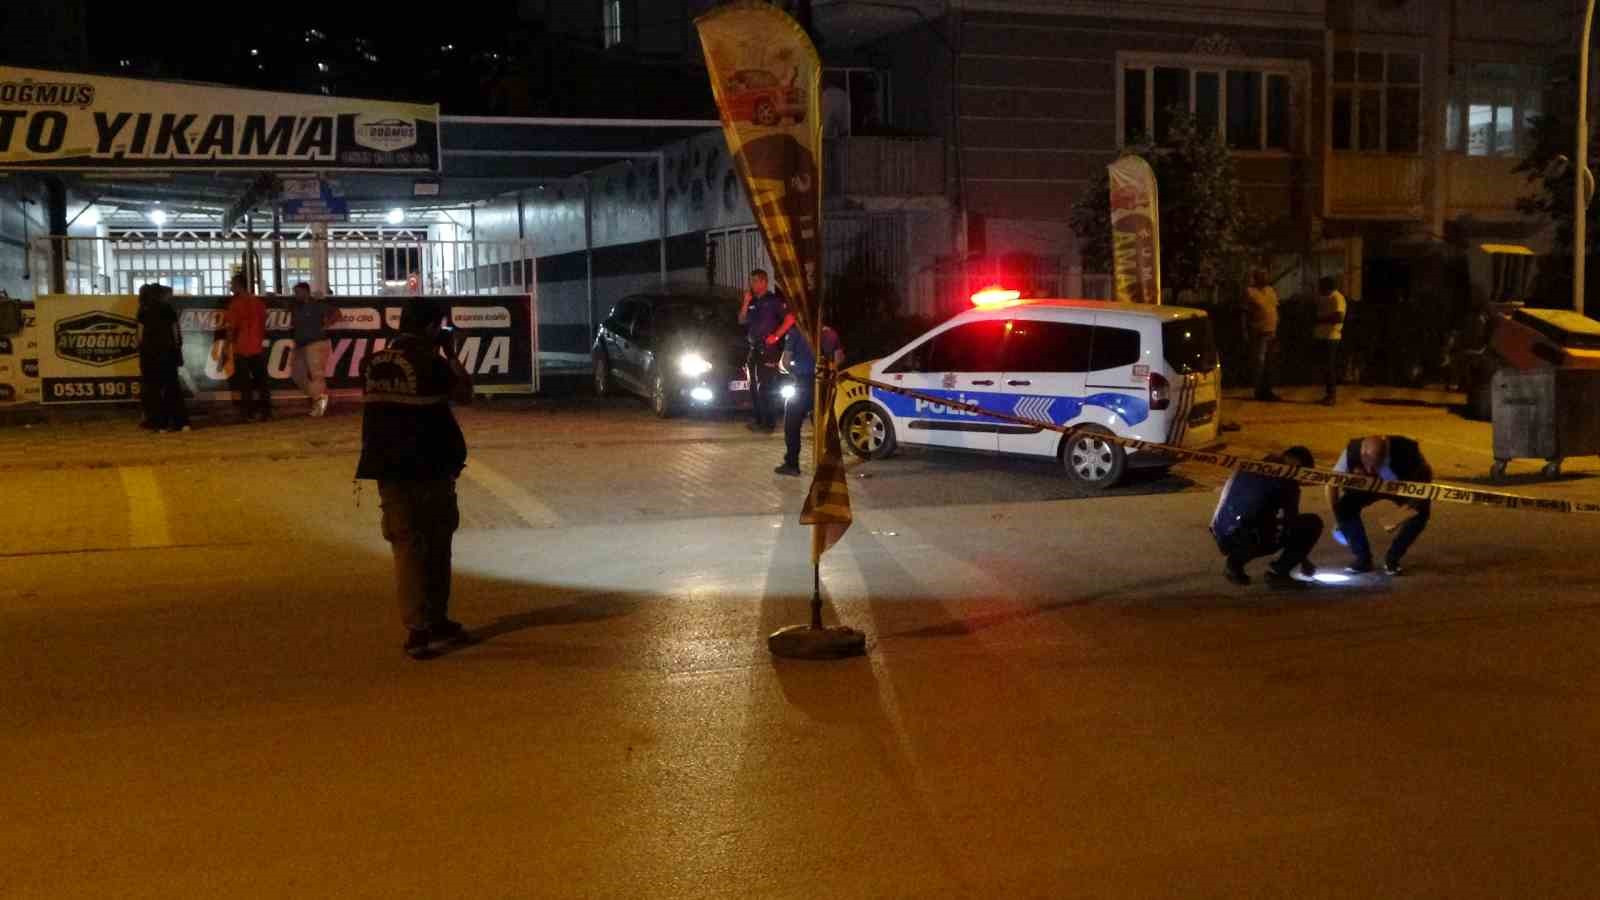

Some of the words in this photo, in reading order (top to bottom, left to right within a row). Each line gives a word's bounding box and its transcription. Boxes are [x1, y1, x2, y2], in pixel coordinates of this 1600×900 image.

[93, 111, 335, 156] YIKAMA
[53, 382, 96, 399] 0533
[100, 382, 127, 397] 190
